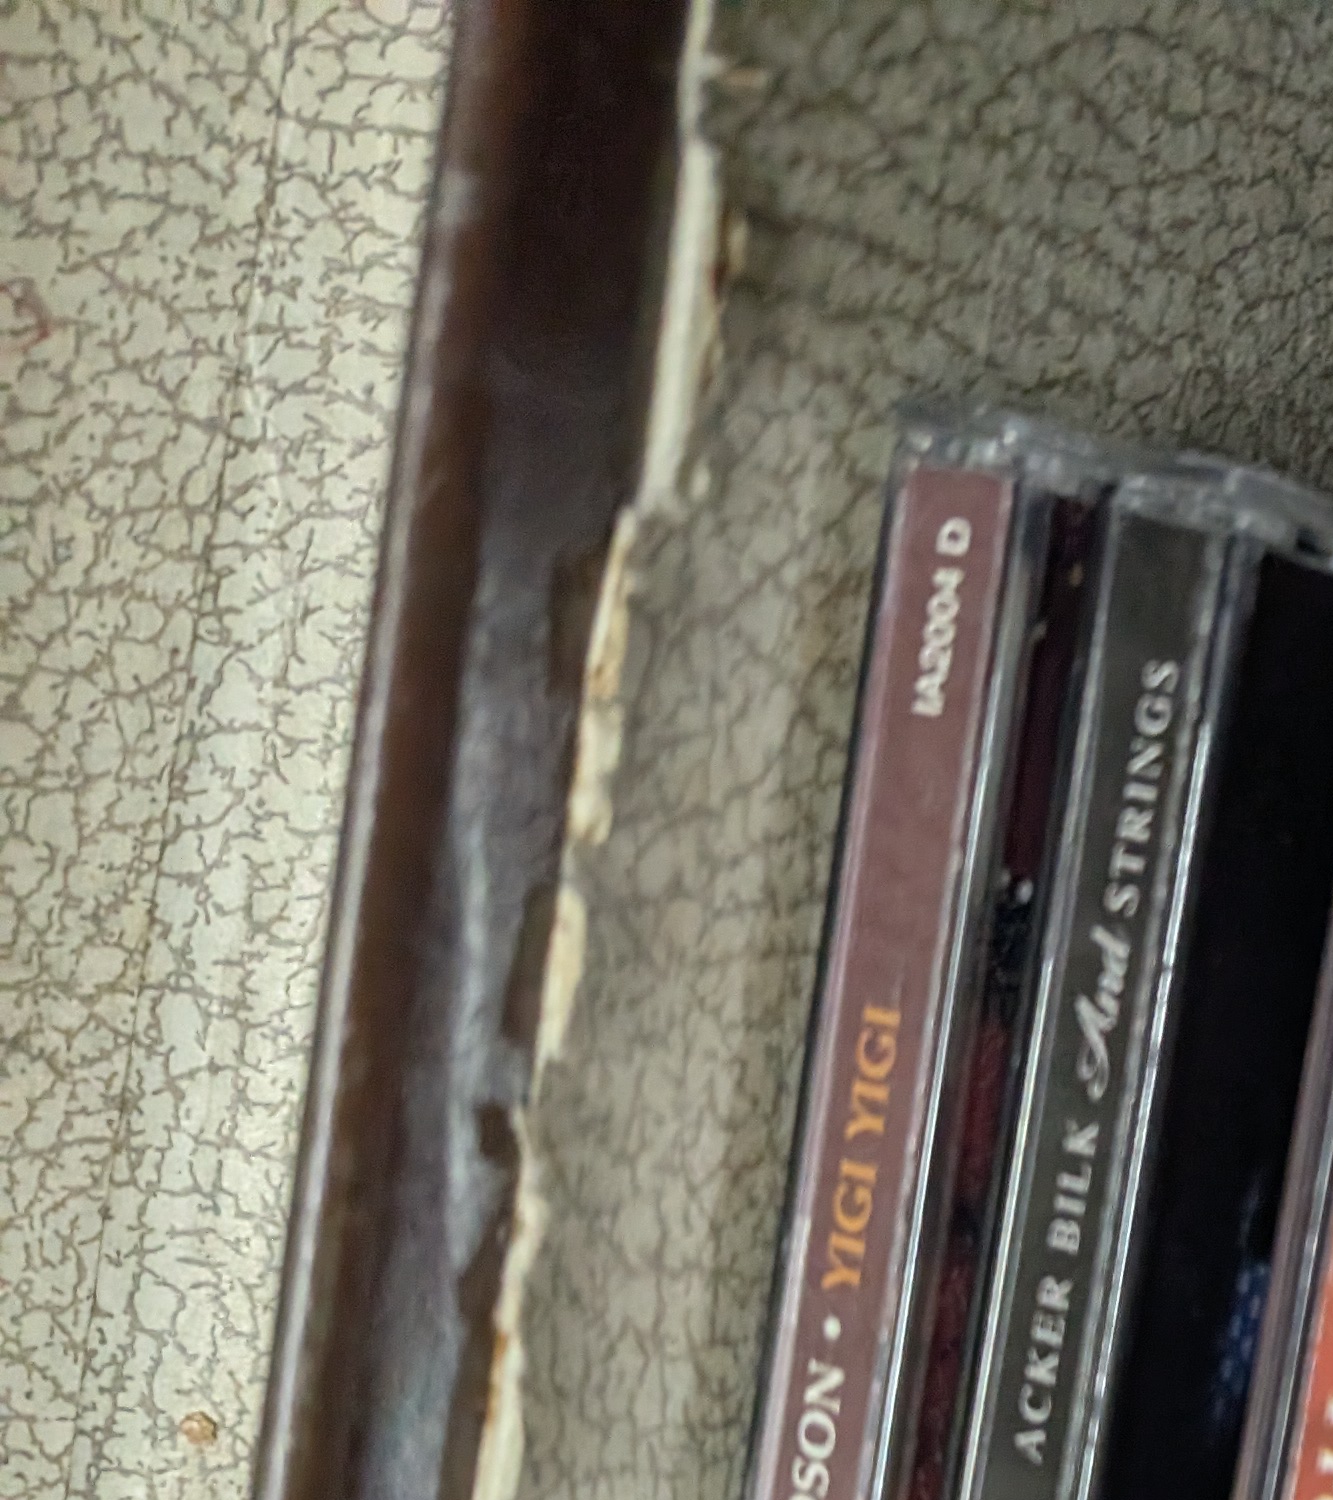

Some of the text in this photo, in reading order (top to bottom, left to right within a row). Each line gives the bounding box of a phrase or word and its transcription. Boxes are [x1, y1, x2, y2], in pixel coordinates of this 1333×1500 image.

[936, 517, 972, 556] D
[846, 1005, 901, 1140] YIGI
[1015, 659, 1181, 1466] ACKER BILK And STRINGS
[823, 1160, 878, 1293] YIGI
